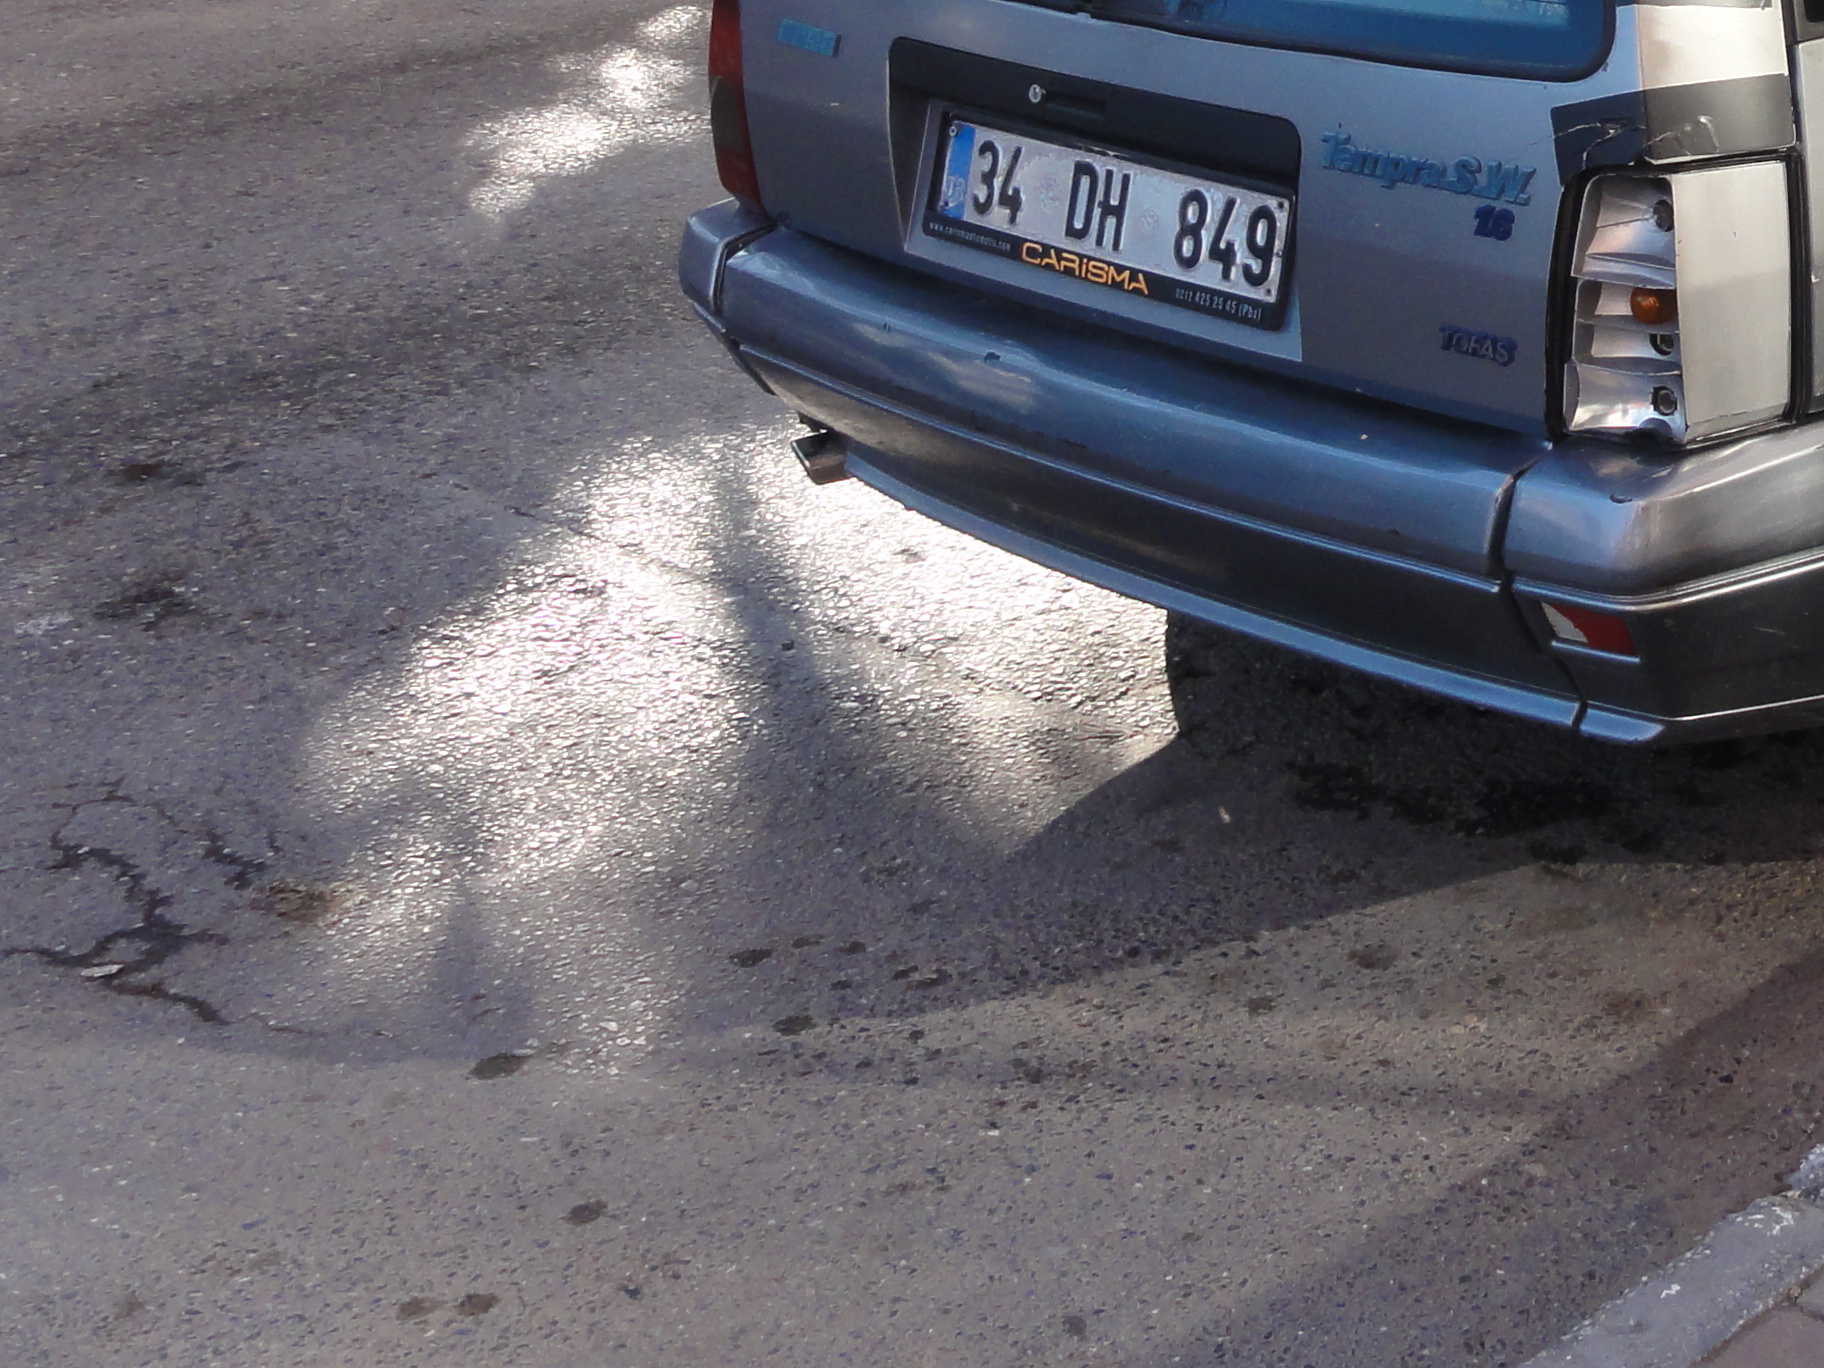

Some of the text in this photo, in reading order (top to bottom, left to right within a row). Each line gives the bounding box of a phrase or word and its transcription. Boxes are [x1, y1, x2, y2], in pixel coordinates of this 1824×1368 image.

[1321, 131, 1446, 190] Tempra
[972, 139, 1278, 287] 34 DH 849
[1194, 291, 1211, 307] 425
[1212, 295, 1223, 310] 25
[1225, 299, 1237, 314] 45
